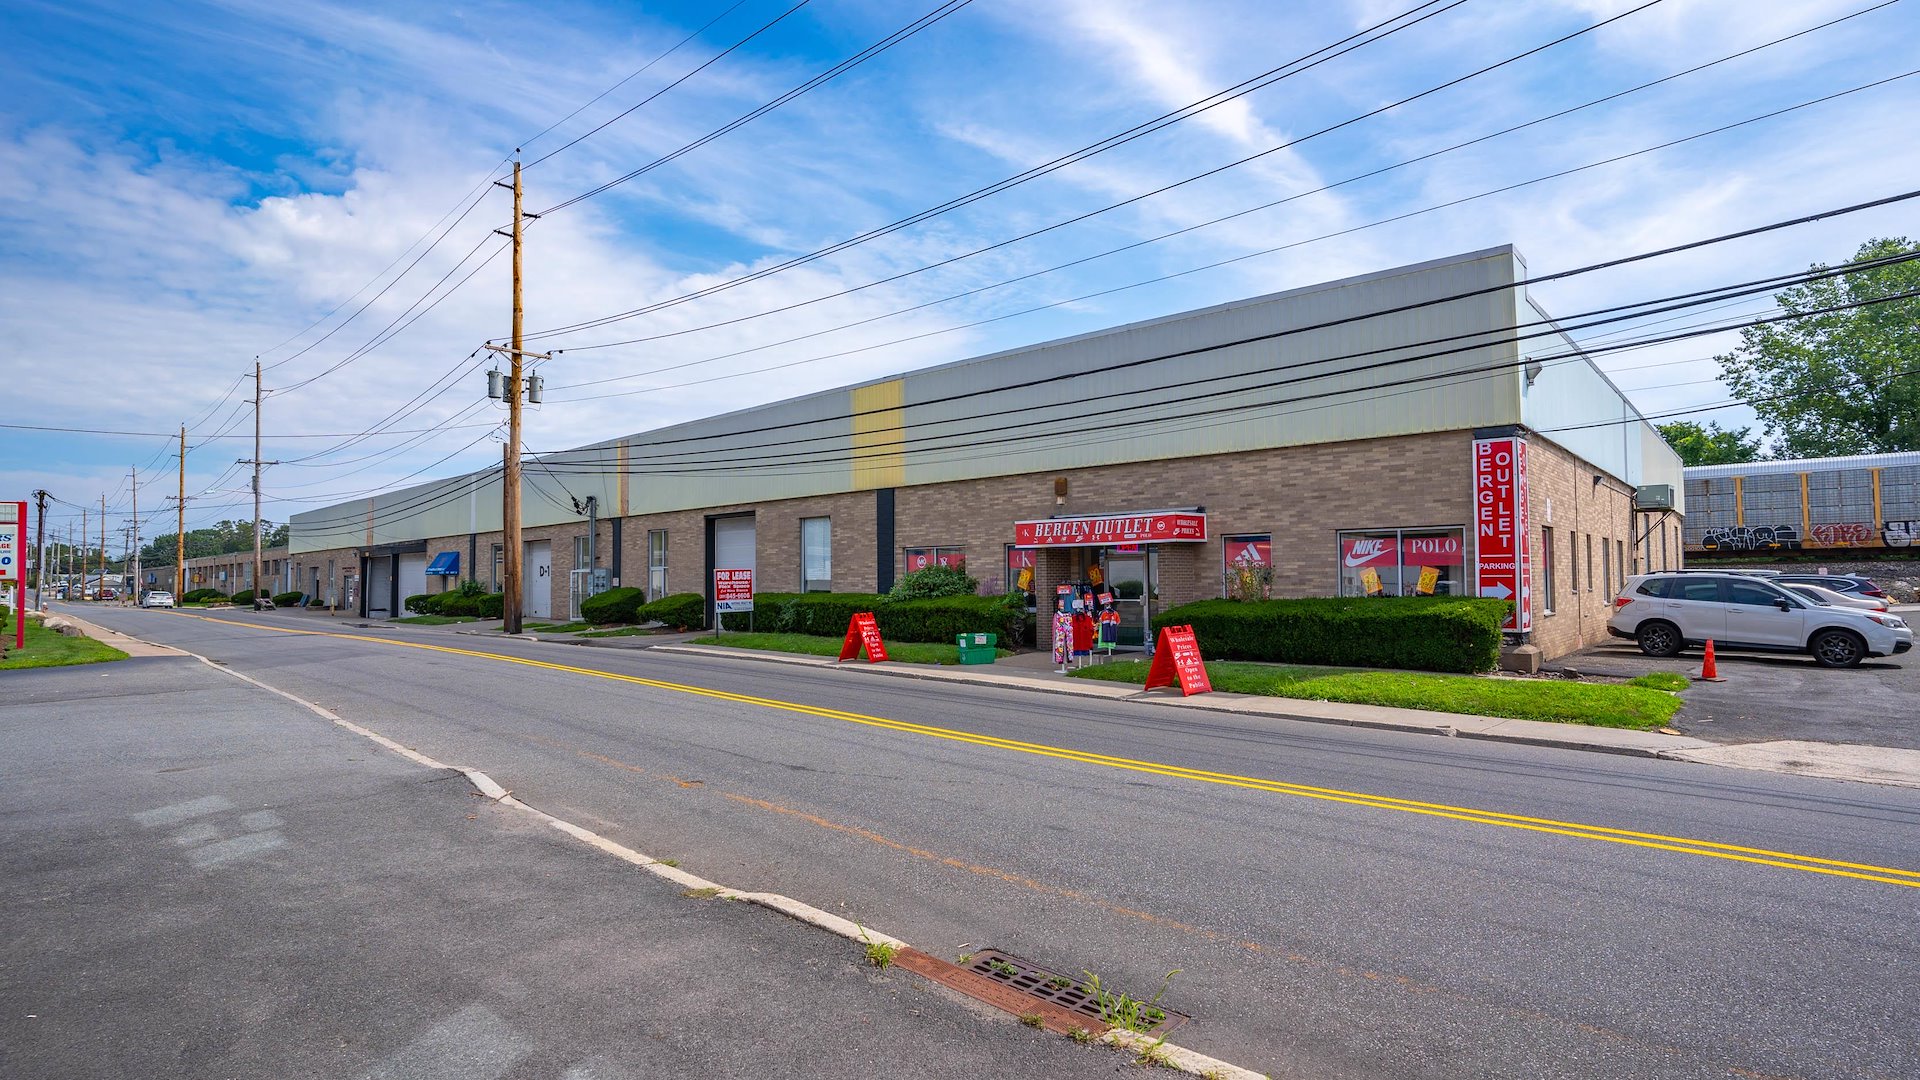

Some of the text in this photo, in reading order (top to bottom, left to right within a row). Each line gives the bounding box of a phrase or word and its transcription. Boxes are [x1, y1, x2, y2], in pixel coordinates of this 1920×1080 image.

[1479, 443, 1493, 537] BERGEN
[1495, 452, 1511, 548] OUTLET
[1034, 517, 1153, 537] BERGEN OUTLET
[1352, 539, 1384, 555] NIKE
[1412, 539, 1457, 553] POLO
[540, 565, 550, 577] D-1
[717, 571, 751, 580] FOR LEASE
